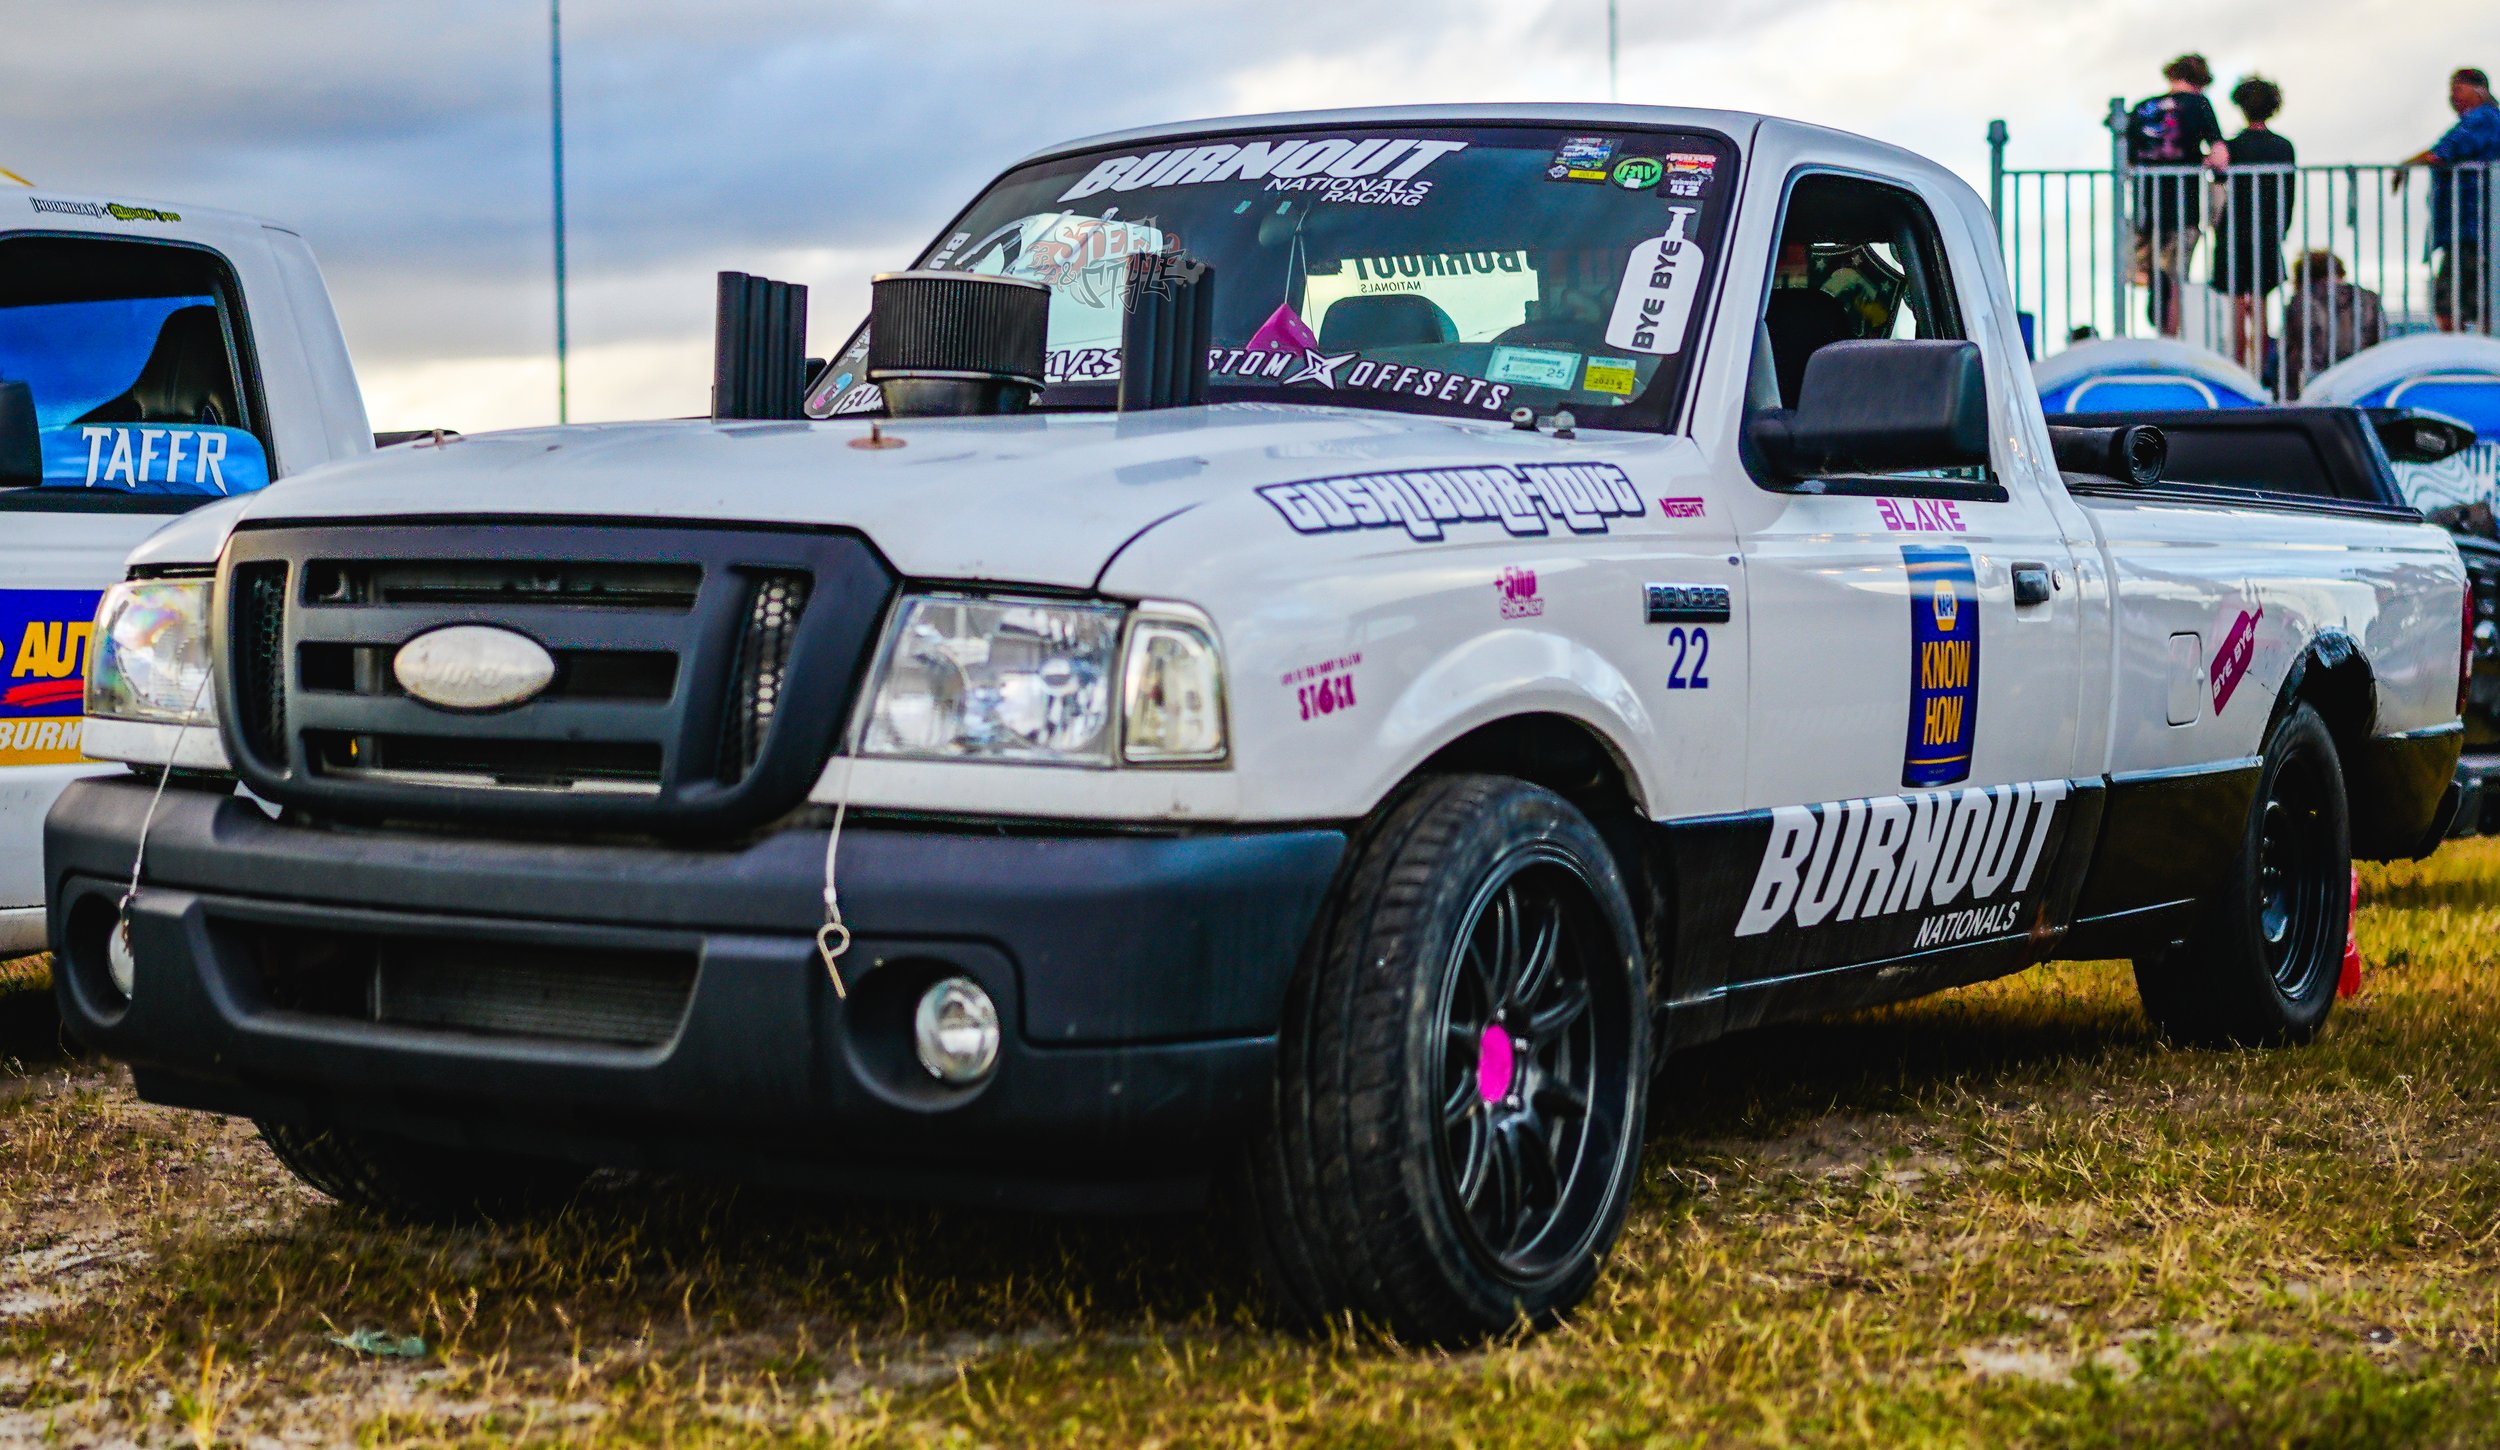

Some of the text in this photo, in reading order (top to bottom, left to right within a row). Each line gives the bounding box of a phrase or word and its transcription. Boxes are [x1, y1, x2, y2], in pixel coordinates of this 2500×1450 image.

[1058, 138, 1468, 203] BURNOUT
[1264, 177, 1433, 195] NATIONALS
[1321, 189, 1424, 207] RACING
[1632, 240, 1682, 349] BYE BYE
[1208, 348, 1512, 411] STOM OFFSETS
[1545, 368, 1565, 379] 25
[82, 426, 229, 497] TAFFR
[1875, 498, 1967, 532] BLAKE
[11, 621, 94, 679] AUT
[1667, 626, 1709, 689] 22
[1921, 640, 1971, 690] KNOW
[2212, 621, 2253, 700] BYE BYE
[0, 721, 83, 751] BURN
[1923, 695, 1964, 746] HOW
[1735, 778, 2067, 938] BURNOUT
[1914, 900, 2021, 950] NATIONALS
